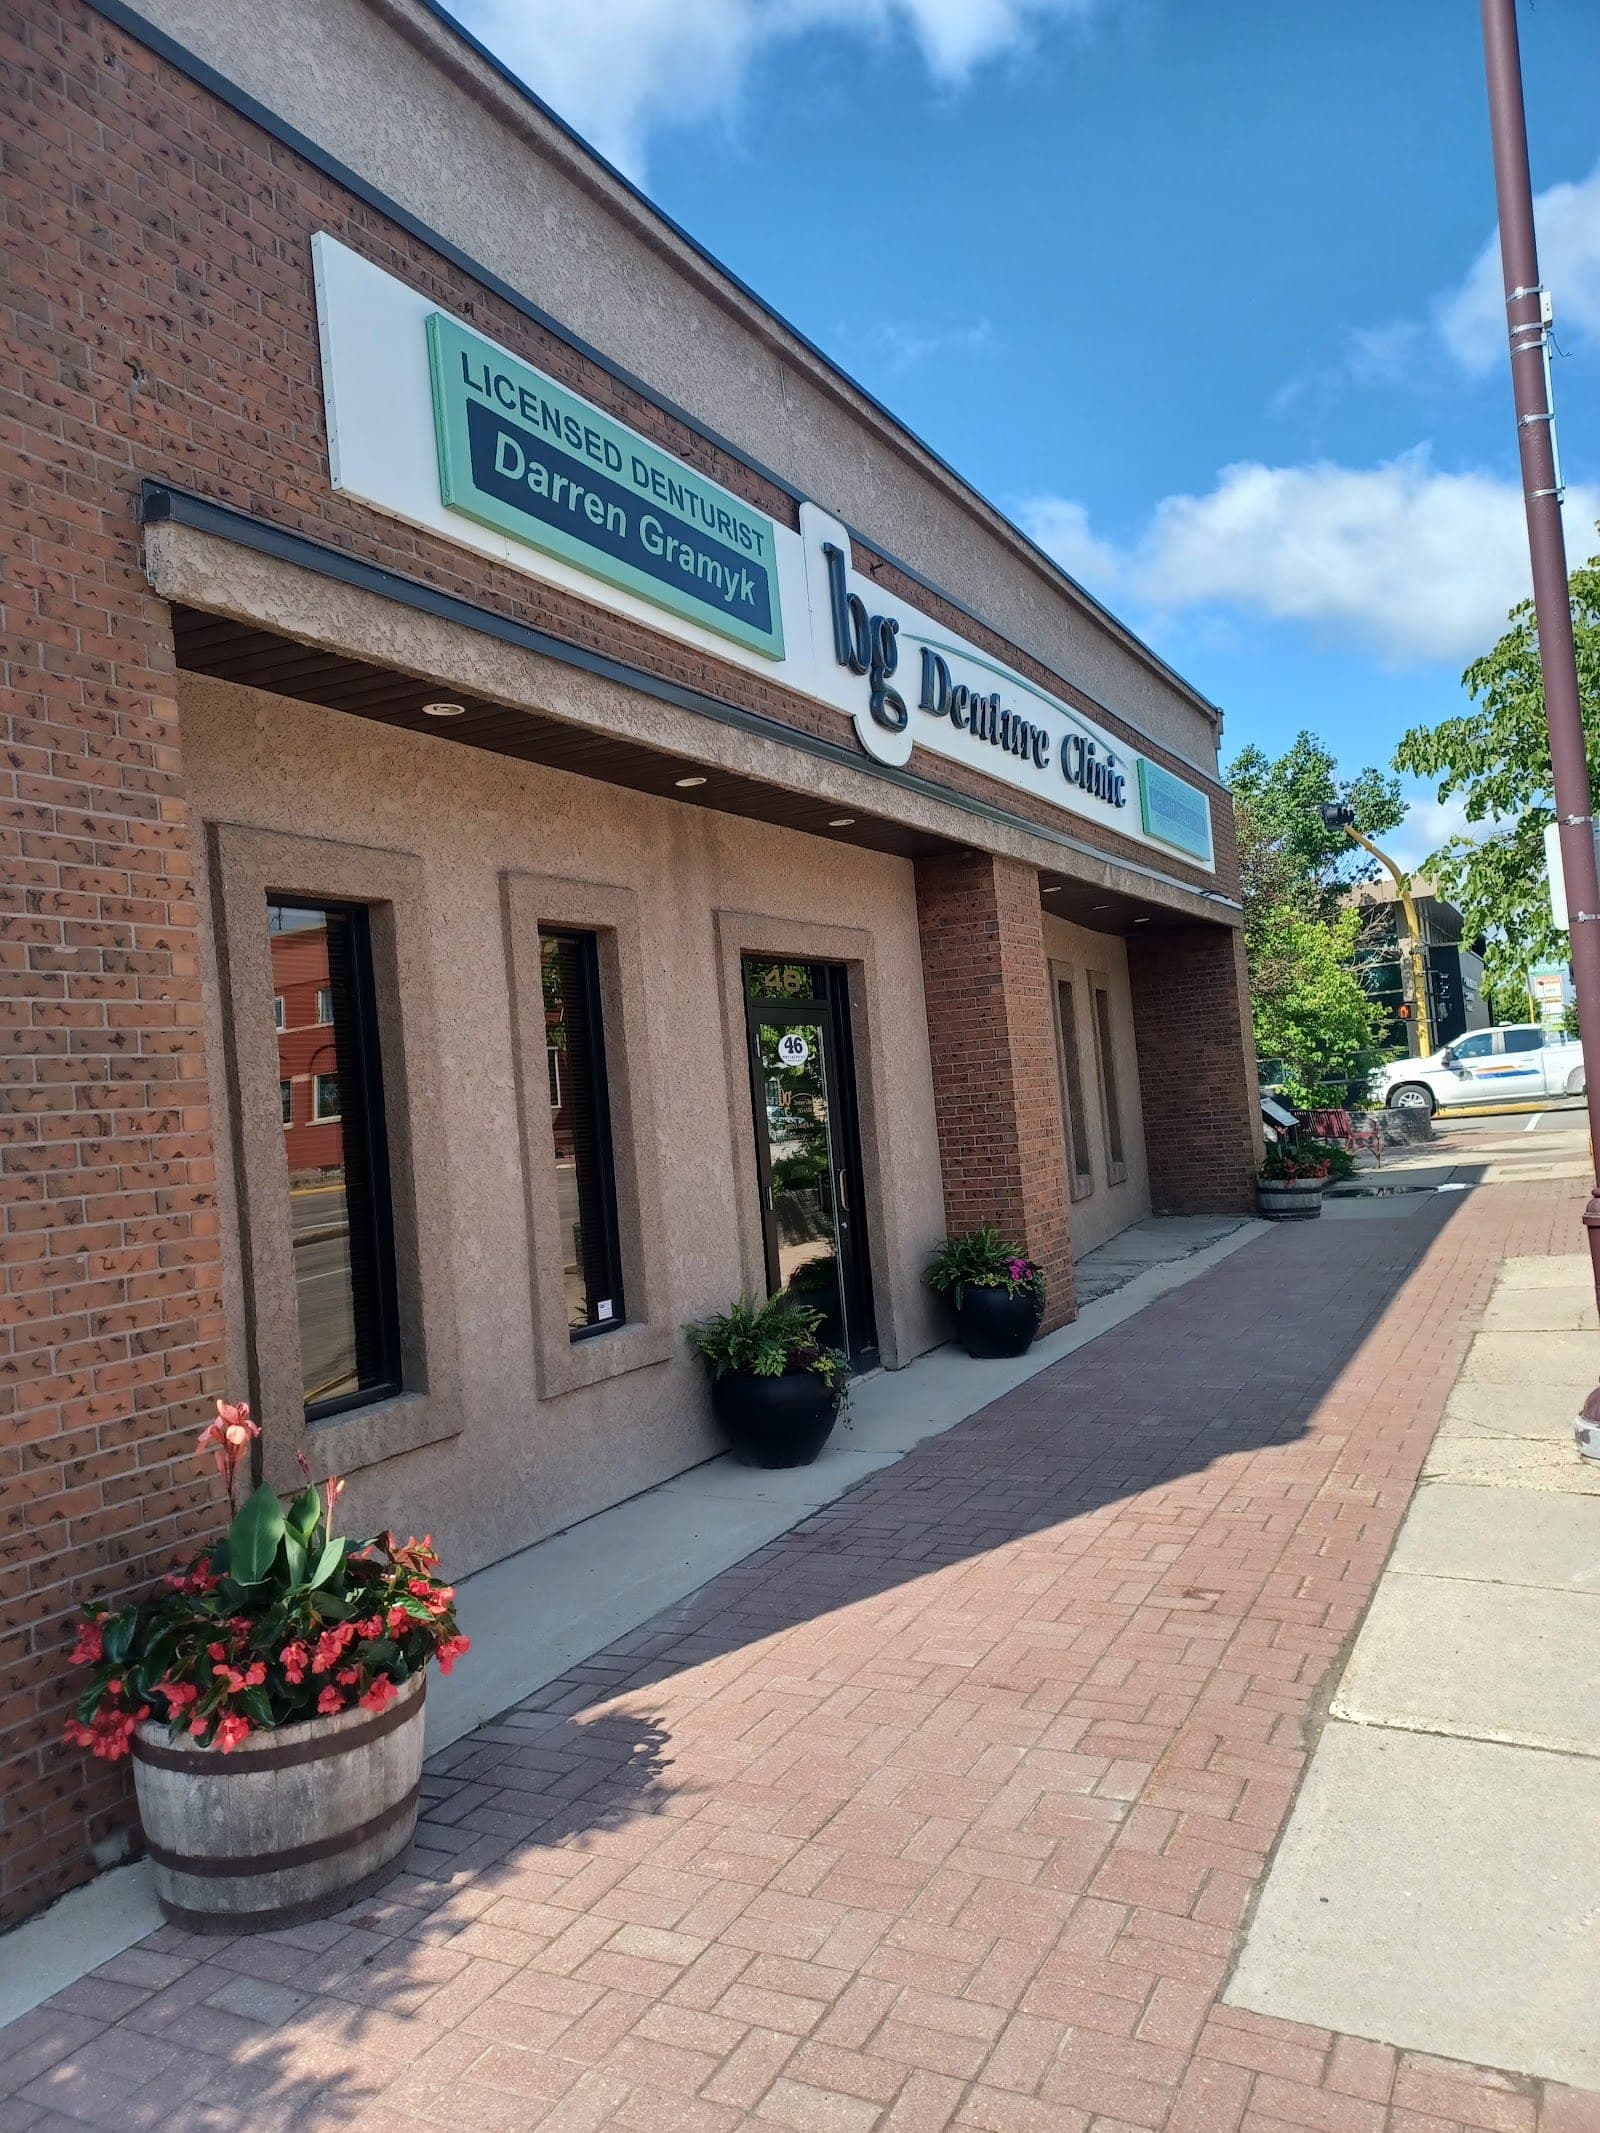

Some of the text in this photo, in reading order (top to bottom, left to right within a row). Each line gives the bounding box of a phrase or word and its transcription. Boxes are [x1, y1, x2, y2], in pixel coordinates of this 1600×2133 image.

[461, 351, 764, 557] LICENSED DENTURIST
[494, 431, 756, 606] Darren Gramyk
[918, 646, 1050, 769] Denture
[1060, 733, 1126, 808] Clinic
[784, 1036, 803, 1054] 46
